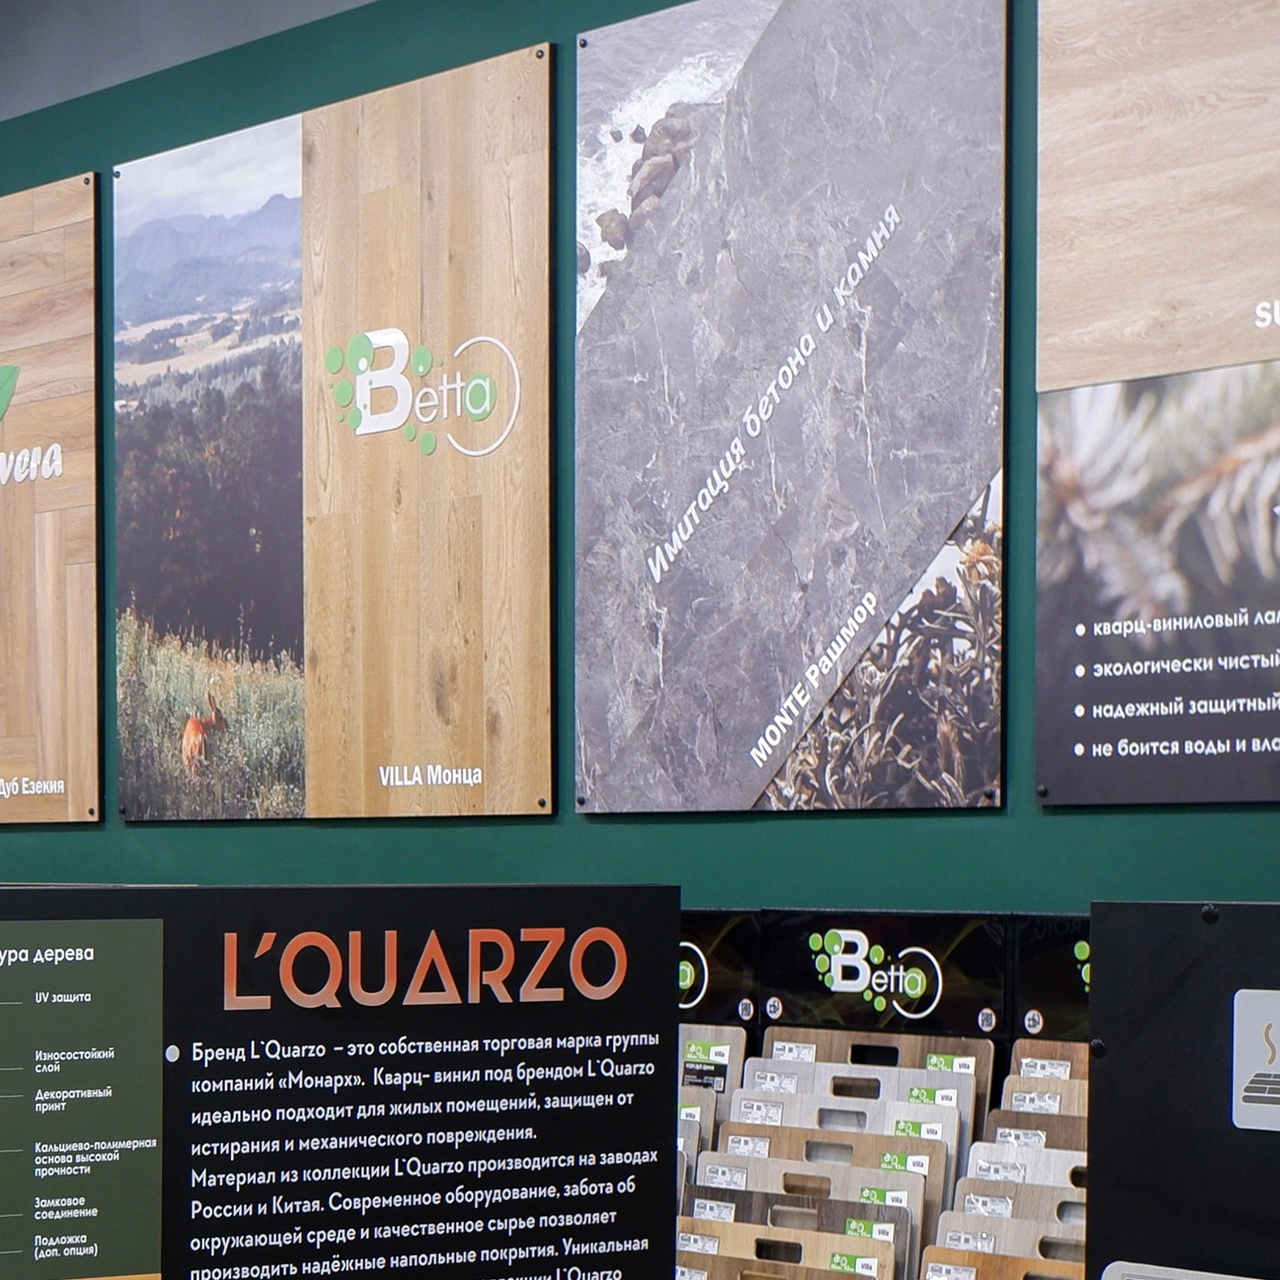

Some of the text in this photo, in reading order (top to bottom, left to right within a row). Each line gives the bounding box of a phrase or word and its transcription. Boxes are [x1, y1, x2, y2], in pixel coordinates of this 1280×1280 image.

[356, 326, 491, 436] Betta
[646, 203, 902, 584] Имитация бетона и камня
[1094, 607, 1248, 638] кварц-виниловый
[1092, 657, 1213, 678] экологически
[750, 590, 879, 768] MONTE Рашмор
[1092, 696, 1183, 719] надежный
[1092, 742, 1112, 757] не
[1118, 738, 1179, 756] боится
[1184, 739, 1230, 756] воды
[1236, 738, 1246, 752] и
[22, 776, 65, 795] Езекия
[378, 764, 482, 787] VILLA Монца
[32, 947, 94, 965] дерева
[830, 928, 925, 995] Betta
[224, 926, 628, 1010] L'QUARZO
[35, 991, 91, 1003] UV защита
[35, 1047, 114, 1061] Износостойкий
[192, 1041, 246, 1068] Бренд
[347, 1043, 374, 1056] это
[378, 1035, 479, 1055] собственная
[482, 1037, 552, 1057] торговая
[556, 1035, 602, 1054] марка
[605, 1033, 659, 1053] группы
[34, 1060, 60, 1073] слой
[191, 1072, 274, 1093] компаний
[278, 1070, 365, 1094] «Монарх».
[373, 1066, 430, 1091] Кварц-
[434, 1069, 480, 1083] винил
[484, 1068, 513, 1083] под
[516, 1061, 583, 1086] брендом
[34, 1085, 112, 1101] Декоративный
[35, 1102, 67, 1114] принт
[191, 1092, 634, 1126] идеально подходит для жилых помещений, защищен от
[34, 1138, 157, 1153] Кальциево-полимерная
[191, 1127, 537, 1161] истирания и механического повреждения.
[34, 1151, 120, 1165] основа высокой
[34, 1165, 91, 1179] прочности
[191, 1168, 275, 1192] Материал
[280, 1169, 298, 1182] из
[303, 1165, 390, 1181] коллекции
[468, 1155, 574, 1178] производится
[578, 1153, 596, 1166] на
[599, 1150, 657, 1165] заводах
[34, 1196, 85, 1208] Замковое
[191, 1174, 636, 1219] России и Китая. Современное оборудование, забота об
[34, 1207, 98, 1220] соединение
[34, 1234, 87, 1248] Подложка
[34, 1243, 98, 1261] (доп. опция)
